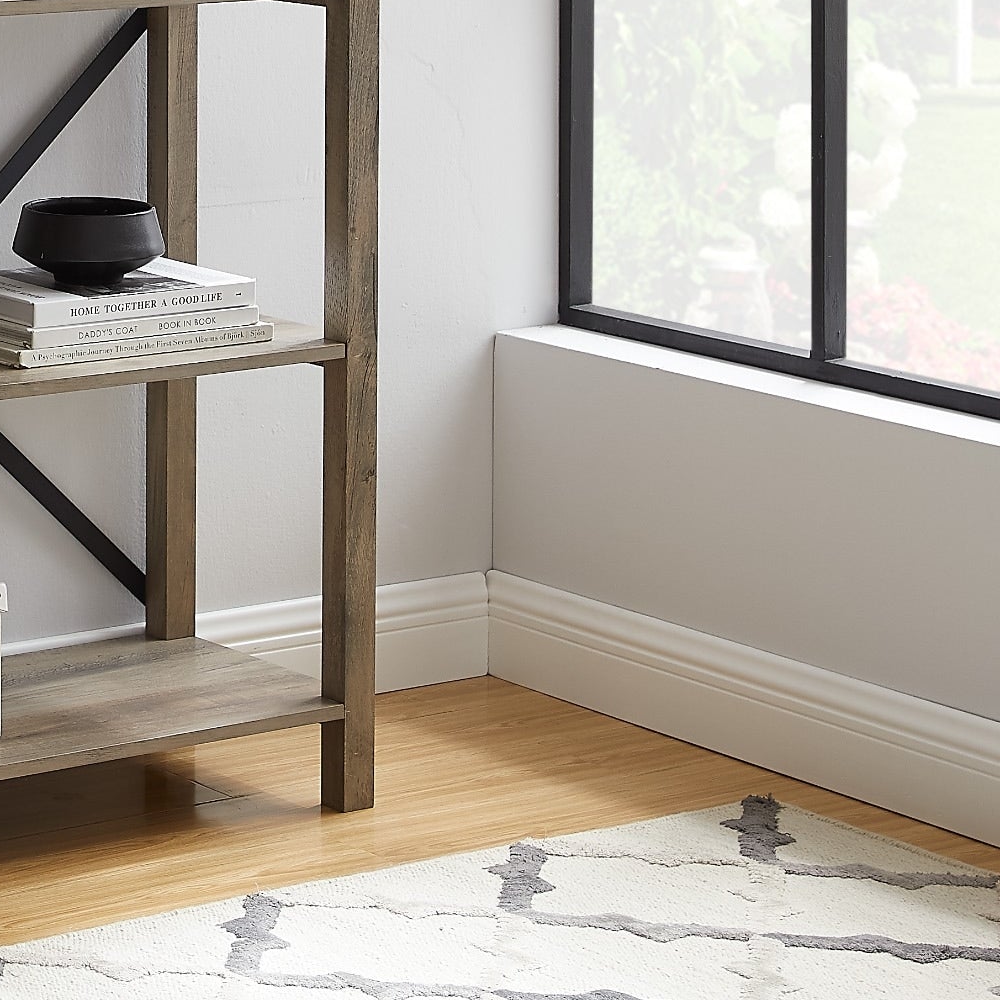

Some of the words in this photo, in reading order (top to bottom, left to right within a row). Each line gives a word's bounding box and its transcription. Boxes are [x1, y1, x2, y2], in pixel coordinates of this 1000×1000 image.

[70, 305, 100, 318] HOME
[104, 299, 157, 315] TOGETHER
[160, 298, 168, 308] A
[171, 295, 200, 307] GOOD
[201, 292, 223, 303] LIFE
[78, 328, 113, 340] DADDY'S
[115, 325, 138, 336] COAT
[158, 319, 181, 331] BOOK
[183, 319, 192, 328] IN
[194, 316, 217, 326] BOOK
[31, 354, 37, 362] A
[115, 342, 143, 354] Through
[144, 341, 155, 350] the
[156, 338, 172, 348] First
[172, 337, 193, 347] Seven
[220, 332, 227, 341] of
